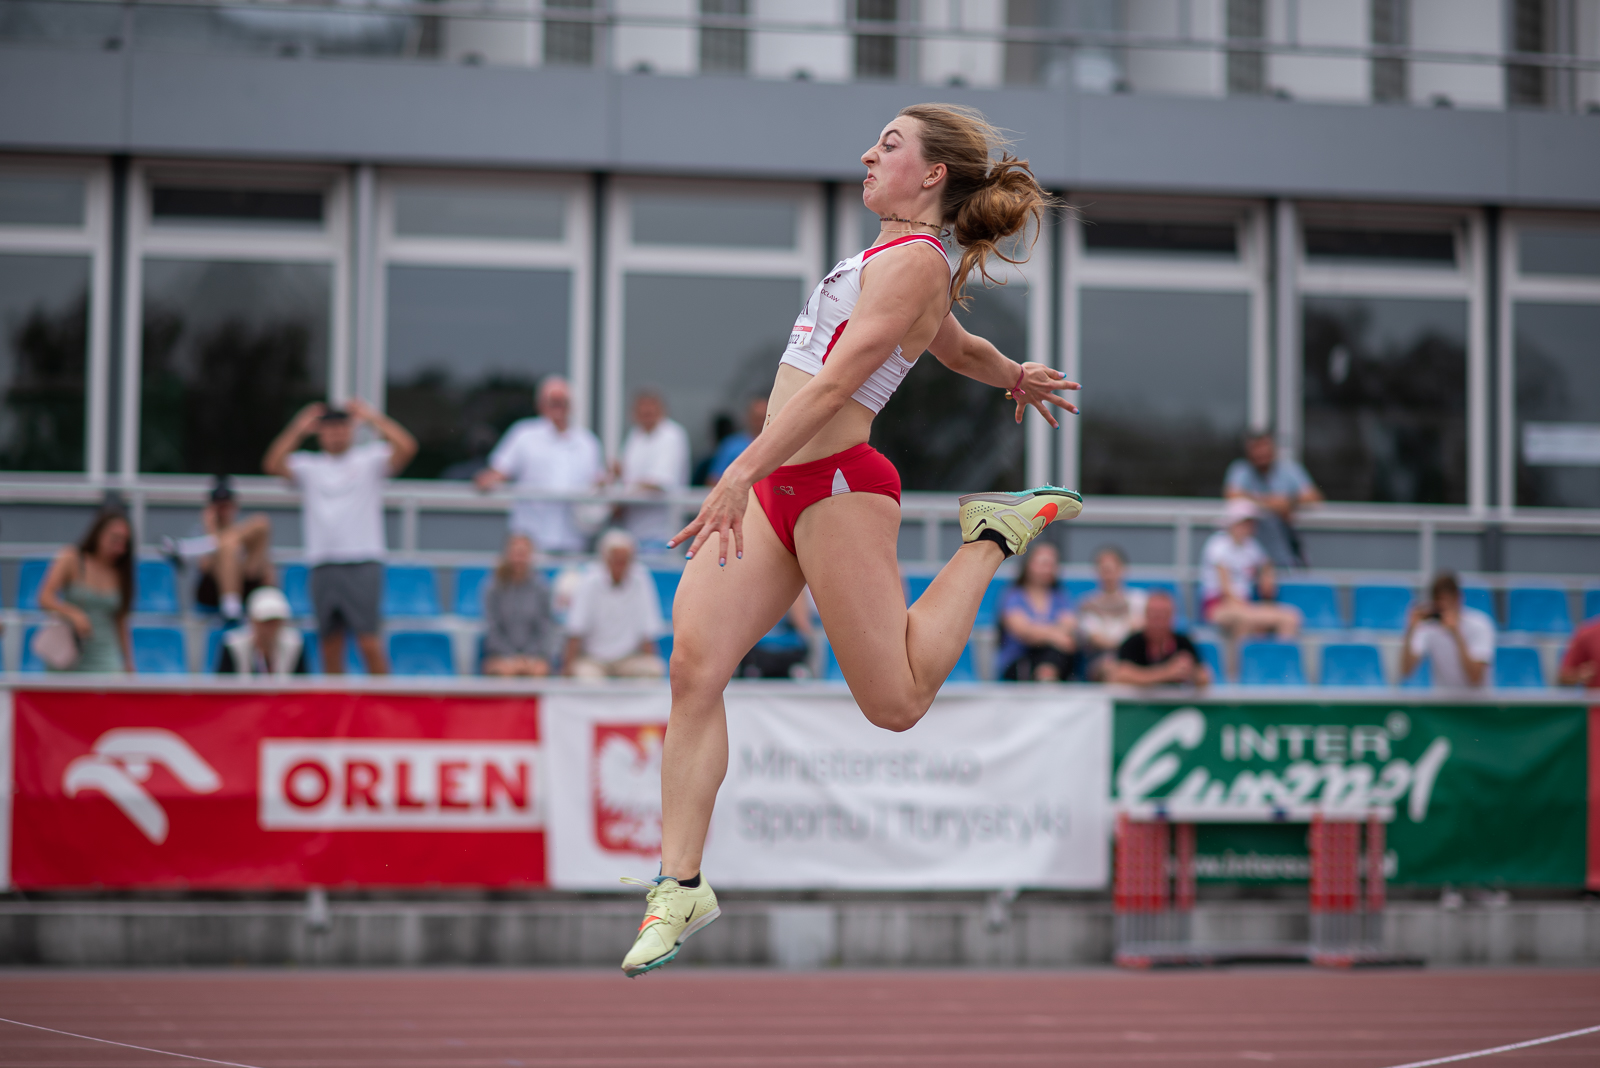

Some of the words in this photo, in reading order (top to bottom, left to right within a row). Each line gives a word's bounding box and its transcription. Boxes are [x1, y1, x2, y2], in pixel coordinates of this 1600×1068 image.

[1220, 723, 1391, 761] INTER
[281, 759, 531, 813] ORLEN
[737, 746, 983, 786] Ministerstwo
[736, 798, 872, 848] Sportu
[896, 799, 1072, 849] Turystyki
